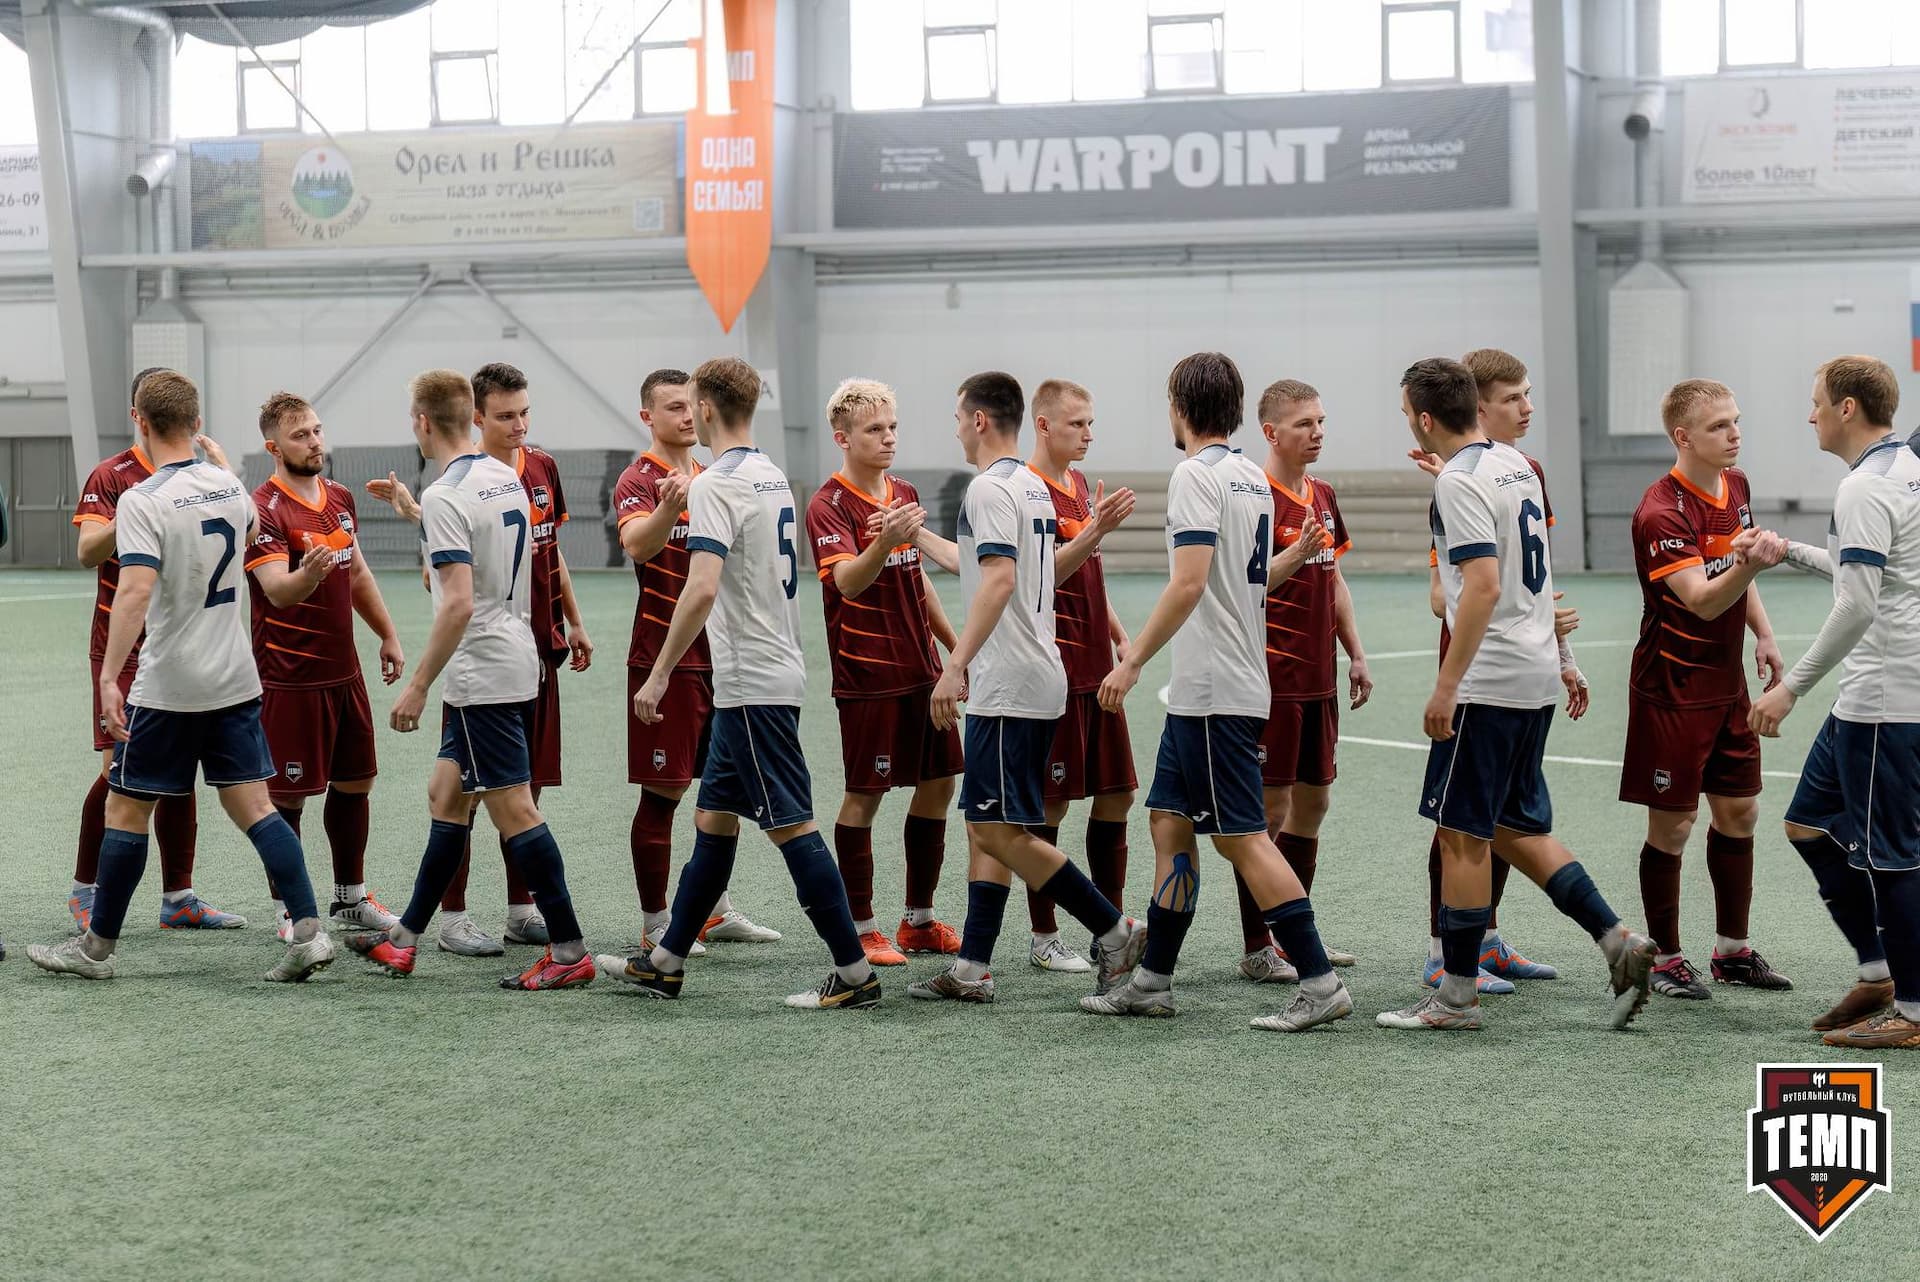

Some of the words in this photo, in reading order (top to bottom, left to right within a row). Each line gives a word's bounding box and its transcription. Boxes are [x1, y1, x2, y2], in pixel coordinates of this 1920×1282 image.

[1363, 129, 1409, 143] АРЕНА
[702, 137, 755, 172] ОДНА
[1695, 165, 1754, 183] более
[694, 180, 764, 212] СЕМЬЯ!
[502, 508, 527, 601] 7
[778, 507, 798, 599] 5
[817, 534, 841, 547] ПСБ
[1518, 498, 1547, 596] 6
[1660, 538, 1685, 550] ПСБ
[201, 517, 236, 609] 2
